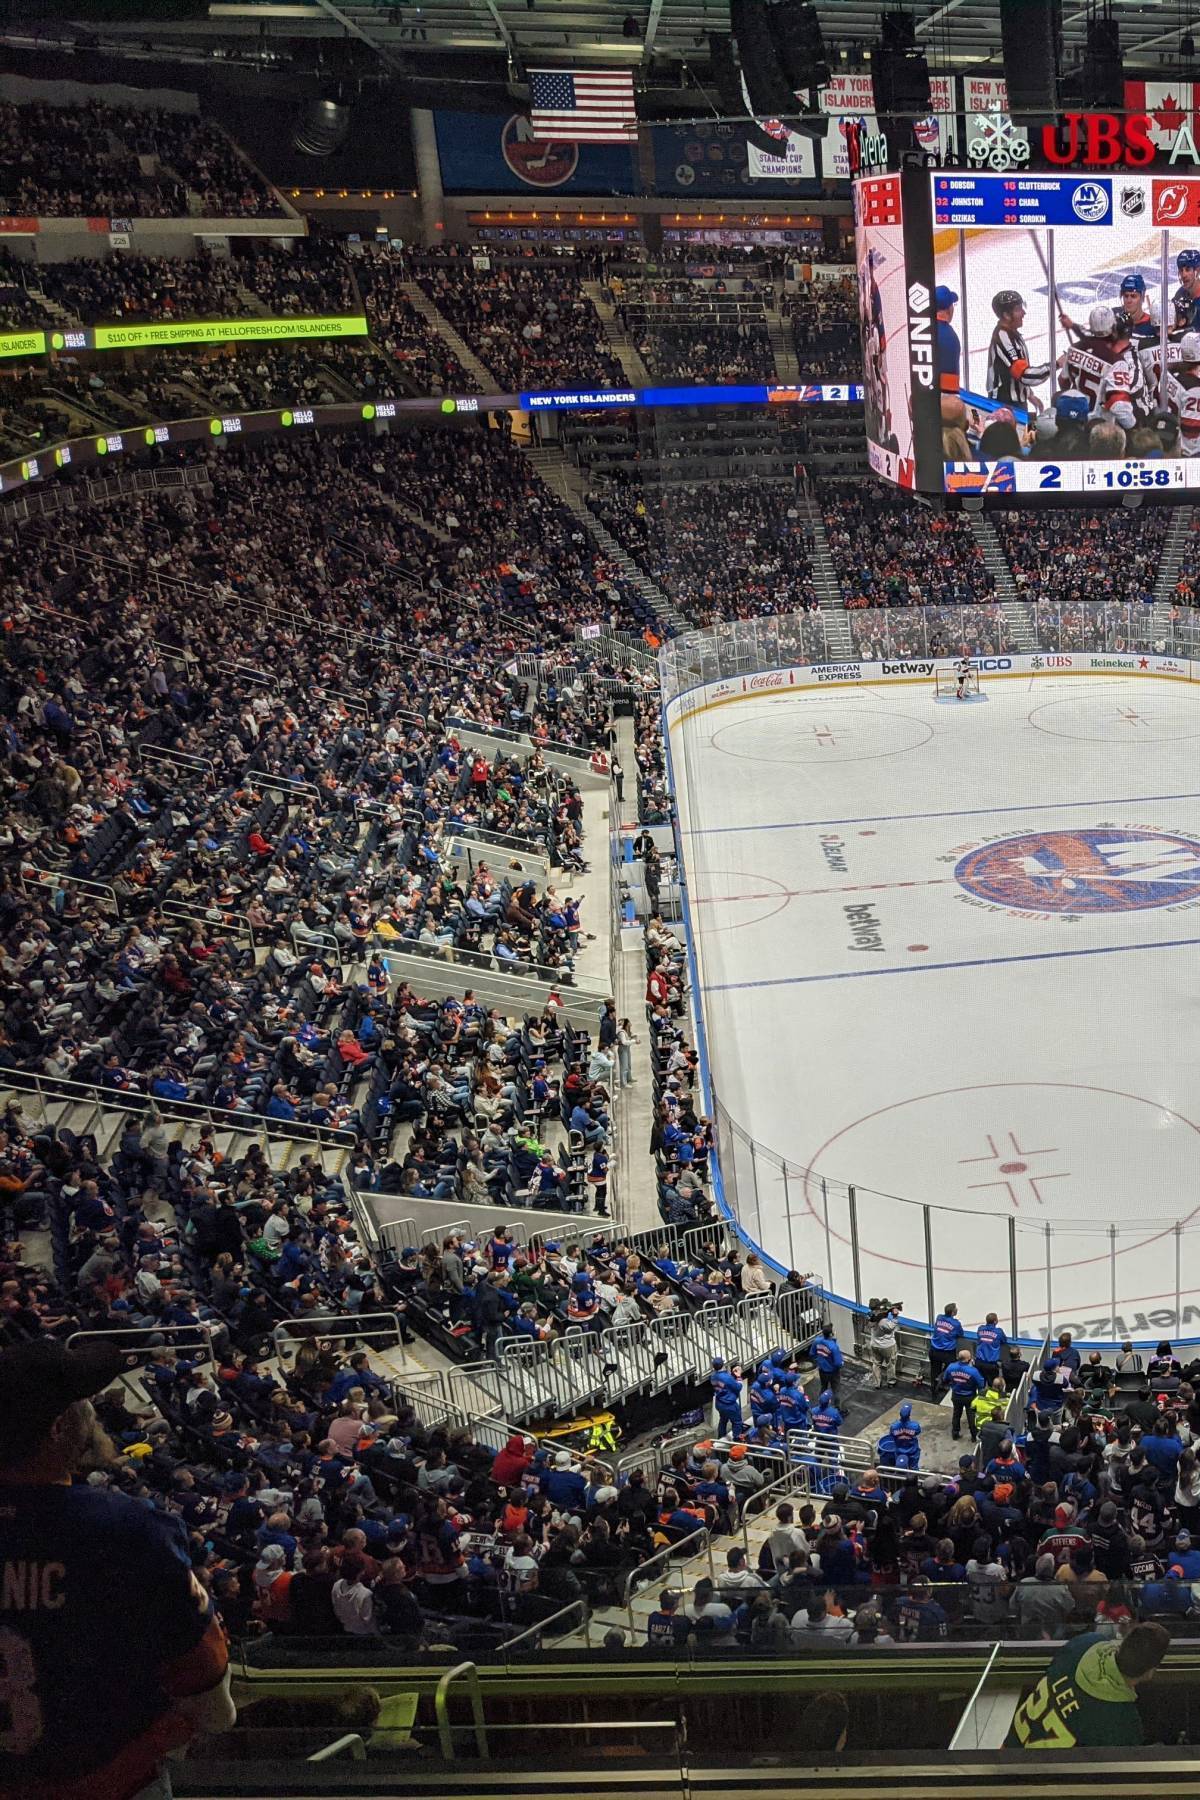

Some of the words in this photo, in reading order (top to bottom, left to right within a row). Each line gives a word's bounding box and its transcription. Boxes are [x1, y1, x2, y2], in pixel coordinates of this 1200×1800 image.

[971, 82, 991, 94] NEW
[1043, 113, 1156, 167] UBS
[762, 165, 802, 174] CHAMPIONS
[950, 181, 975, 189] DOBSON
[1018, 182, 1060, 191] CLUTTERBUCK
[951, 198, 983, 207] JOHNSTON
[1019, 199, 1039, 207] CHARA
[951, 214, 975, 223] CIZIKAS
[1019, 215, 1046, 223] SOROKIN
[64, 333, 85, 341] HELLO
[107, 333, 127, 343] $110
[128, 332, 143, 342] OFF
[150, 329, 169, 340] FREE
[169, 328, 204, 340] SHIPPING
[206, 328, 216, 338] AT
[65, 340, 86, 348] FRESH
[911, 317, 933, 388] NFP
[530, 397, 551, 405] NEW
[553, 396, 578, 404] YORK
[579, 393, 635, 404] ISLANDERS
[830, 388, 841, 399] 2
[1039, 466, 1061, 488] 2
[1104, 470, 1170, 487] 10:58
[1046, 656, 1073, 667] UBS
[1090, 658, 1135, 668] Heineken
[811, 665, 860, 674] AMERICAN
[882, 662, 934, 676] betway
[751, 673, 783, 689] Coca-Cola
[818, 672, 862, 682] EXPRESS
[1125, 823, 1163, 832] UBS
[949, 840, 981, 855] UBS
[981, 827, 1035, 844] Arena
[954, 893, 1006, 914] Arena
[1007, 910, 1050, 921] UBS
[843, 903, 886, 952] betway
[1052, 1537, 1077, 1546] STEVENS
[3, 1561, 66, 1610] NIC
[1051, 1675, 1079, 1719] LEE
